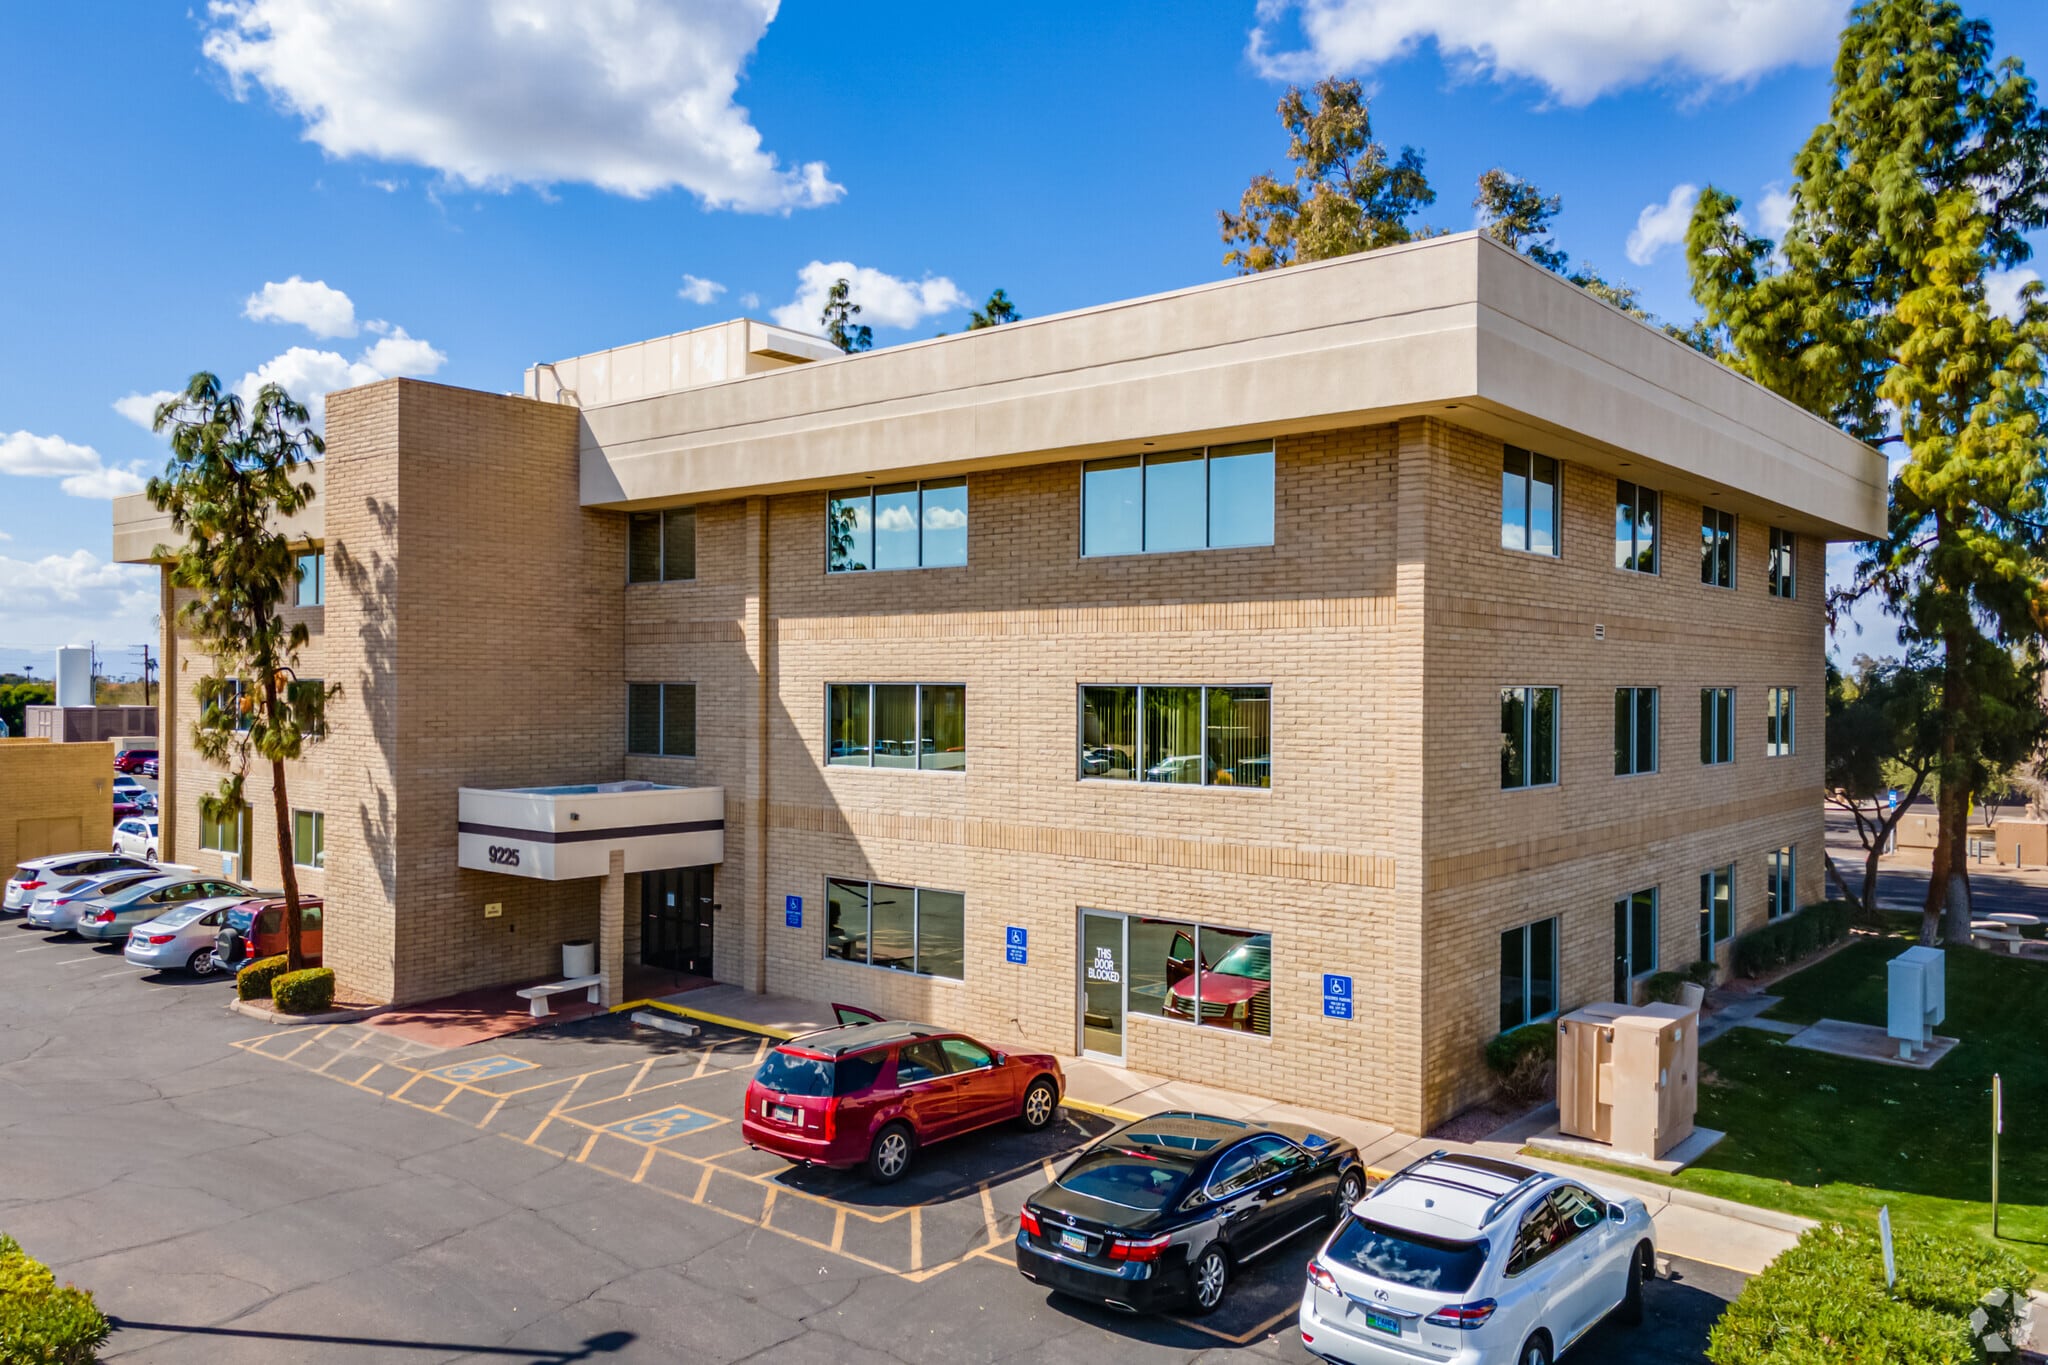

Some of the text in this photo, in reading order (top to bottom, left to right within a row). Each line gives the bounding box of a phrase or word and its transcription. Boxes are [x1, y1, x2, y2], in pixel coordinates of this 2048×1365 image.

[488, 845, 520, 867] 9225
[1096, 946, 1112, 960] THIS
[1094, 958, 1114, 971] DOOR
[1088, 967, 1120, 983] BLOCKED
